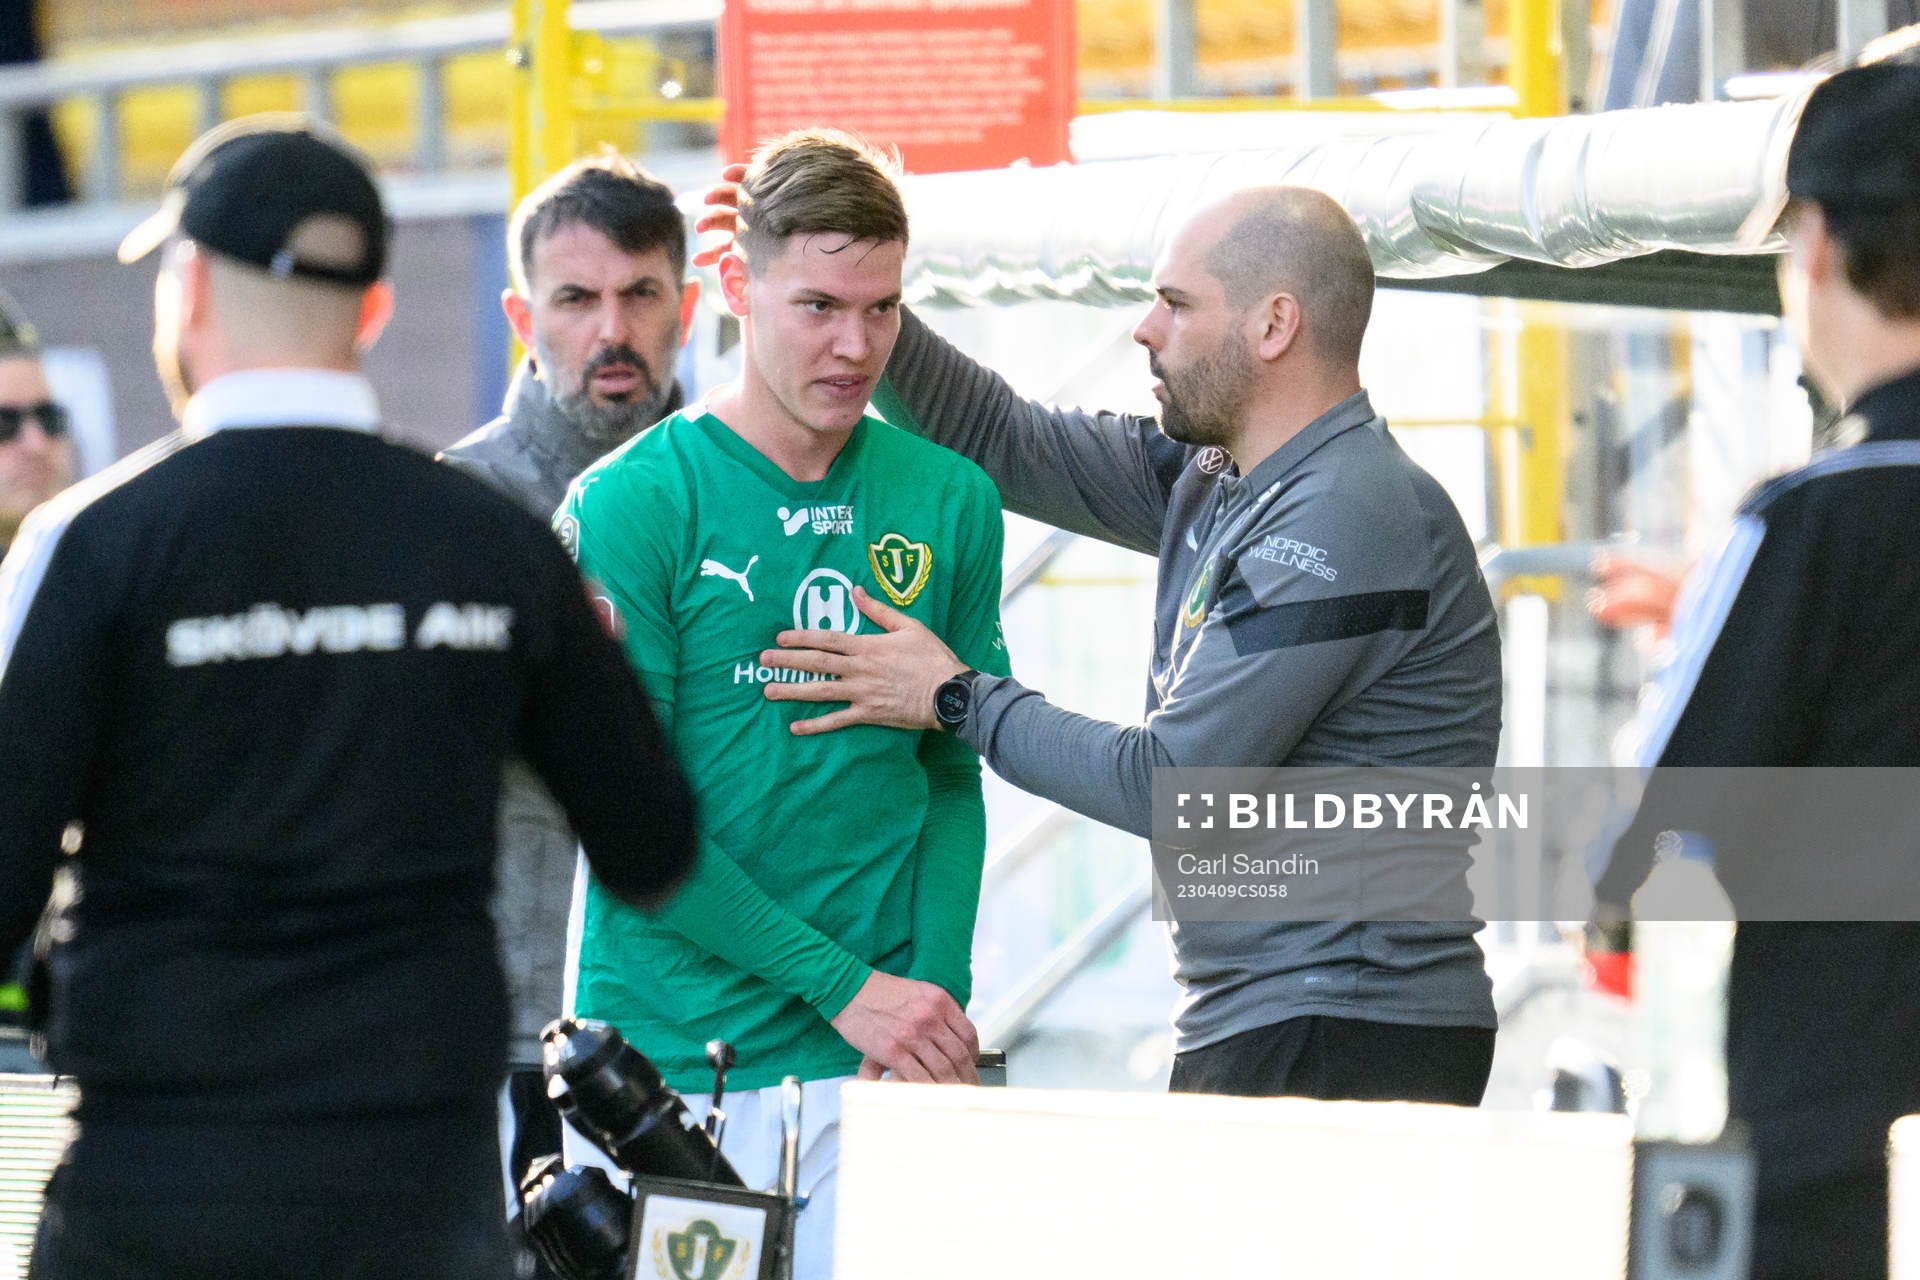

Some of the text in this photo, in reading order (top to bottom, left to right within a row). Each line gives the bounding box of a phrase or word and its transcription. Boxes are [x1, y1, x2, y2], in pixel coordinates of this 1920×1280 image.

[810, 505, 854, 521] INTER
[811, 520, 854, 535] SPORT
[1263, 534, 1328, 562] NORDIC
[1249, 547, 1338, 582] WELLNESS
[166, 601, 514, 667] SKÖVDE AIK
